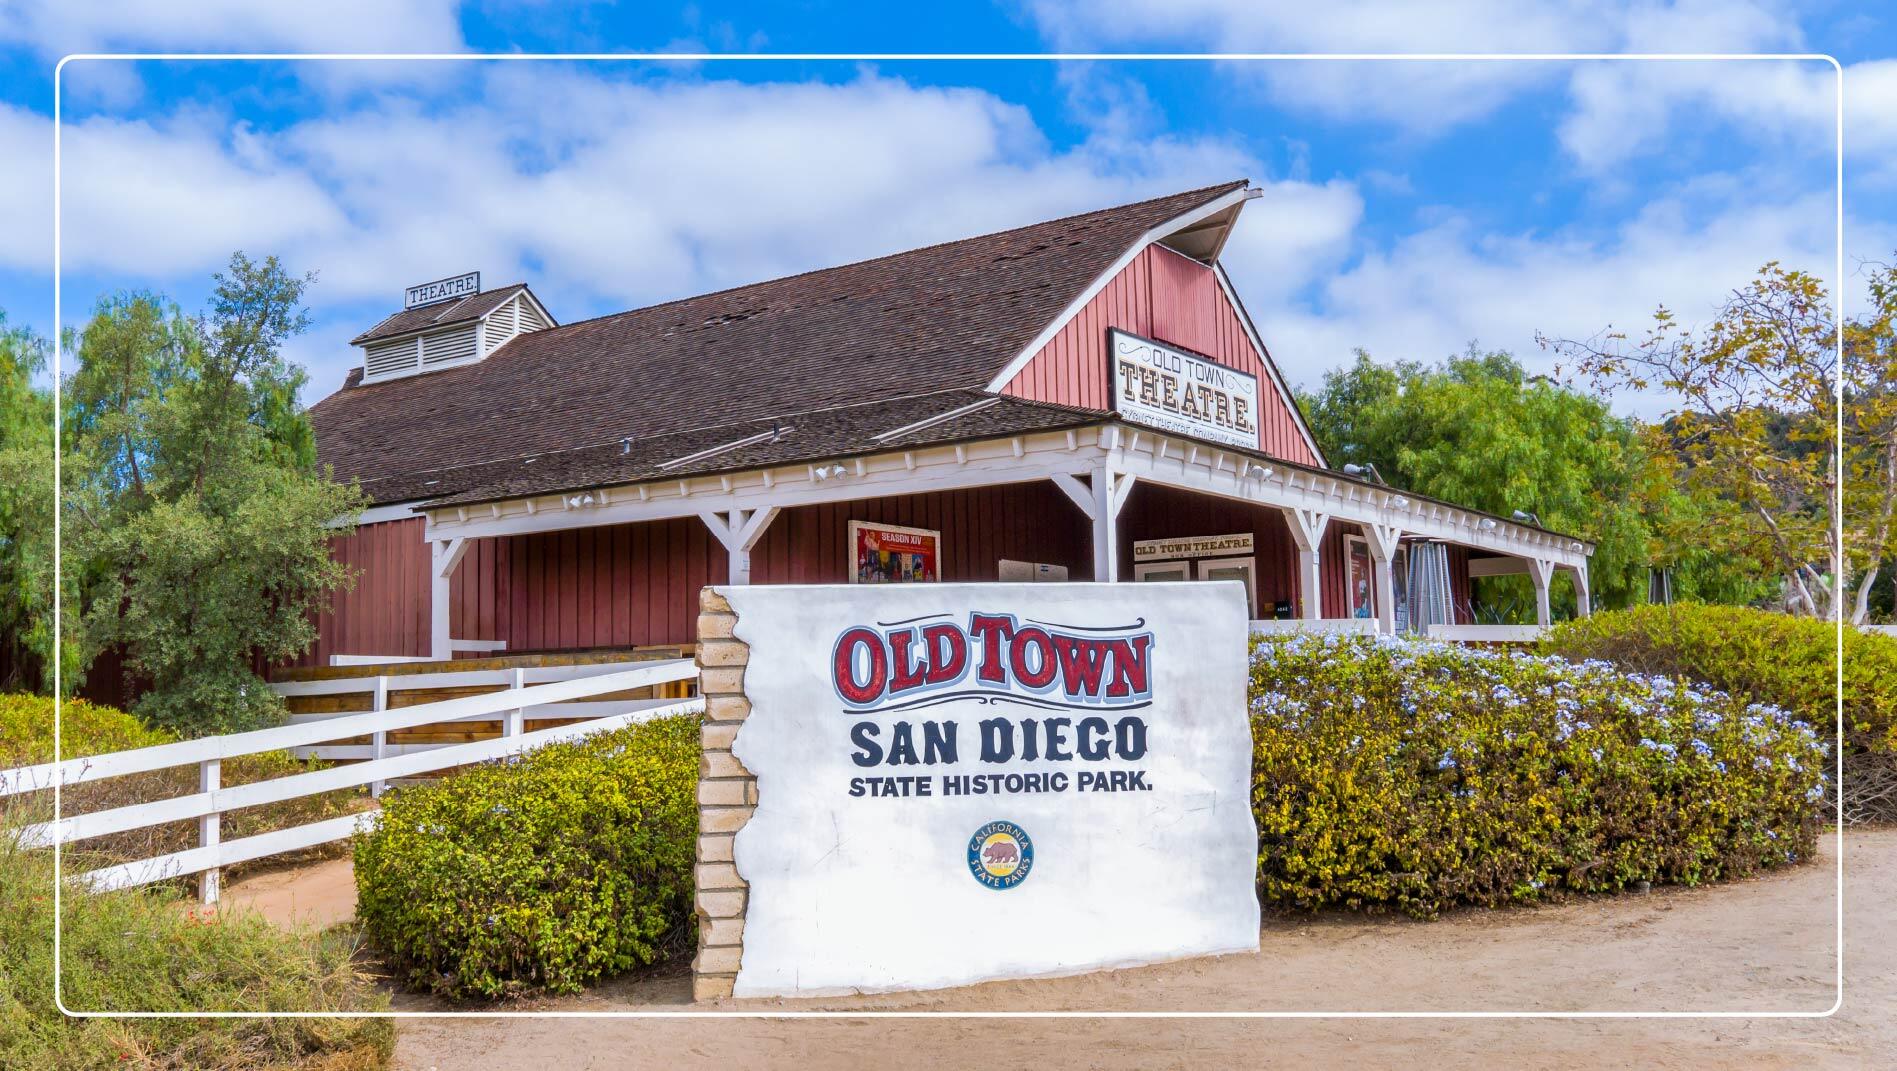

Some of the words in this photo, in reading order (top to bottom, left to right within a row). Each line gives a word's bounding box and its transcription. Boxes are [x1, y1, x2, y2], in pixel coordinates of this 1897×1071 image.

[410, 276, 477, 303] THEATRE.
[1153, 349, 1181, 374] OLD
[1186, 359, 1225, 388] TOWN
[1119, 359, 1255, 434] THEATRE.
[881, 532, 910, 544] SEASON
[910, 536, 922, 545] XIV
[1135, 546, 1156, 555] OLD
[1160, 543, 1192, 553] TOWN
[831, 621, 972, 709] OLD
[969, 611, 1155, 704] TOWN
[850, 720, 958, 768] SAN
[979, 716, 1148, 764] DIEGO
[848, 776, 932, 798] STATE
[943, 772, 1069, 796] HISTORIC
[1077, 770, 1153, 793] PARK.
[971, 823, 1029, 852] CALIFORNIA
[970, 859, 1000, 887] STATE
[1004, 858, 1031, 887] PARKS
